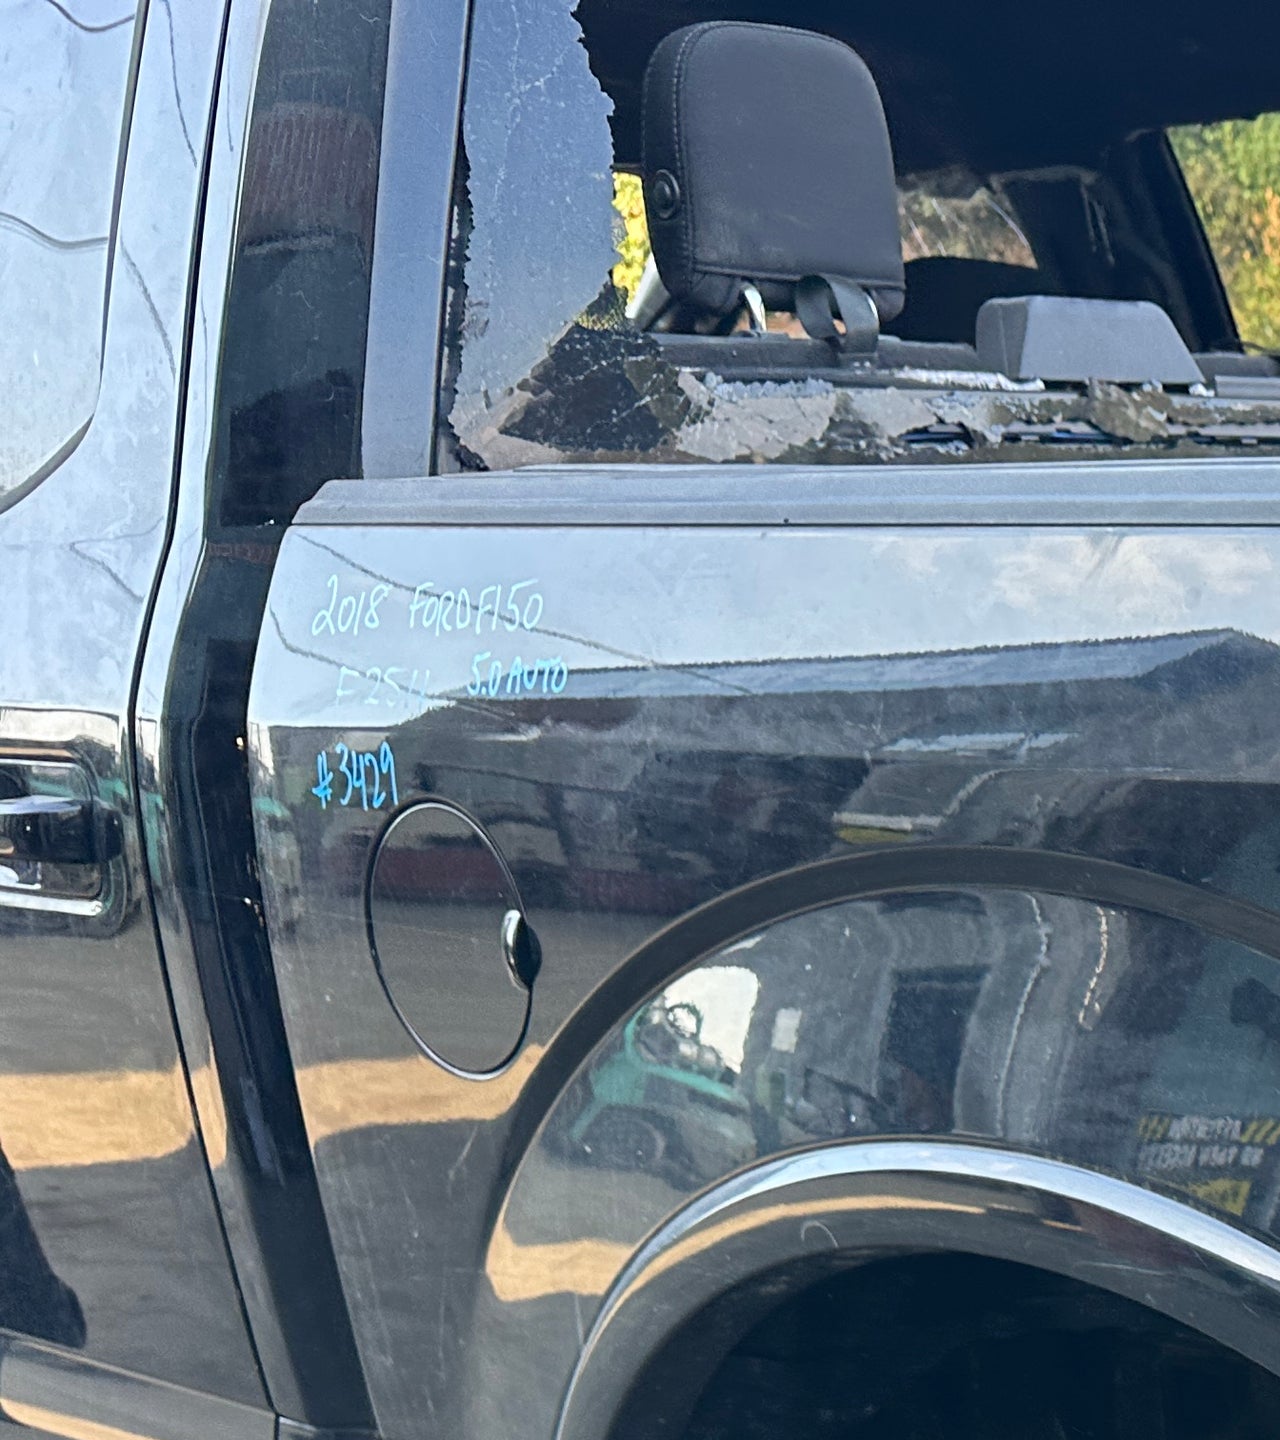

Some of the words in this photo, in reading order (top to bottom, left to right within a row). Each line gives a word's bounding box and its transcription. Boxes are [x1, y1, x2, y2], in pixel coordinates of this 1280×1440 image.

[311, 574, 393, 636] 2018
[408, 582, 471, 636] FORD
[474, 578, 544, 635] F150
[506, 655, 569, 695] AUTO
[311, 740, 399, 811] #3429
